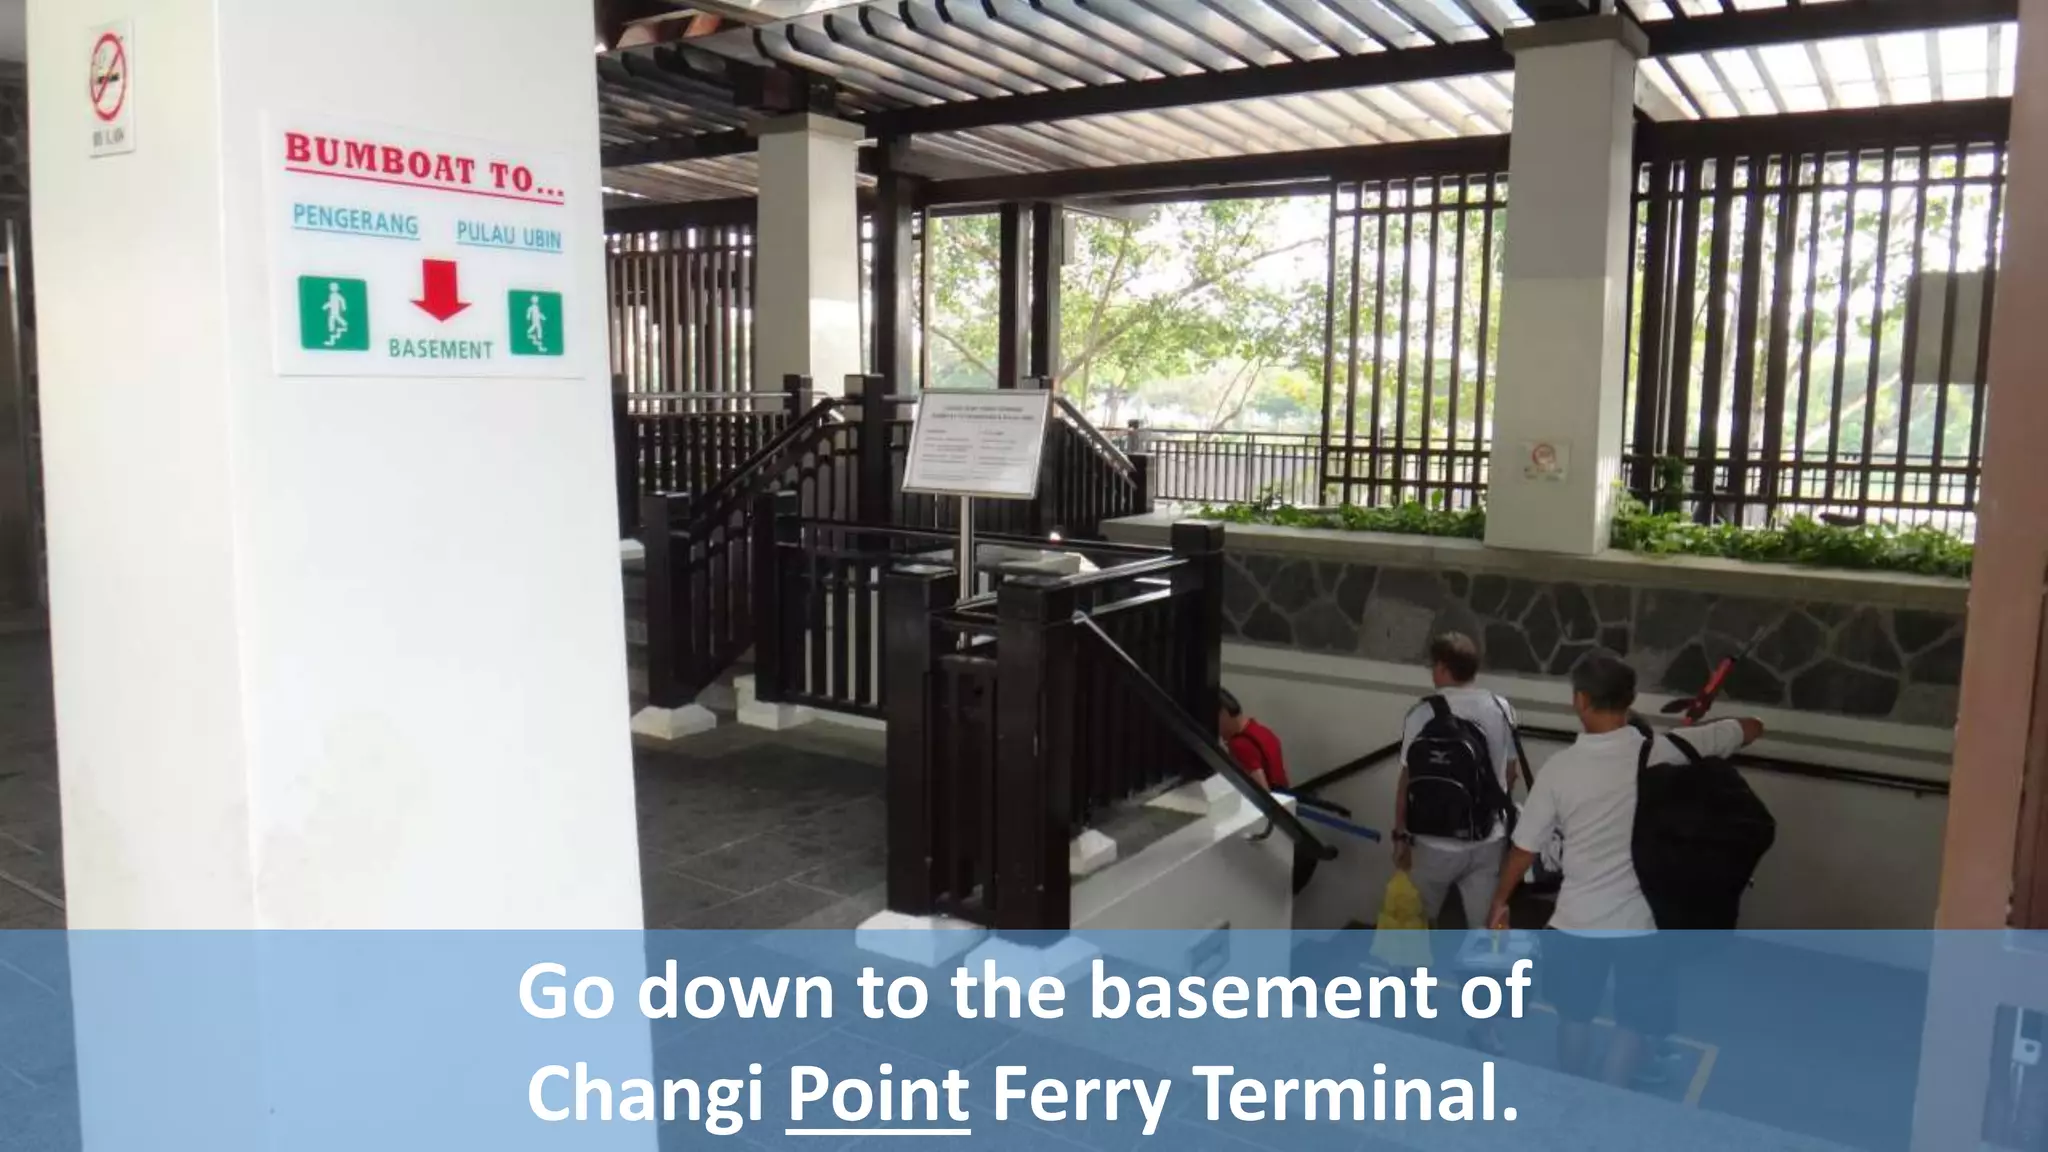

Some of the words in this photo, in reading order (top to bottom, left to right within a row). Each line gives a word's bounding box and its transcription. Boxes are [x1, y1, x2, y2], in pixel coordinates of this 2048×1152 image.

[284, 132, 475, 184] BUMBOAT
[490, 162, 564, 198] TO...
[293, 203, 419, 235] PENGERANG
[457, 219, 515, 245] PULAU
[523, 228, 562, 249] UBIN
[388, 338, 494, 360] BASEMENT
